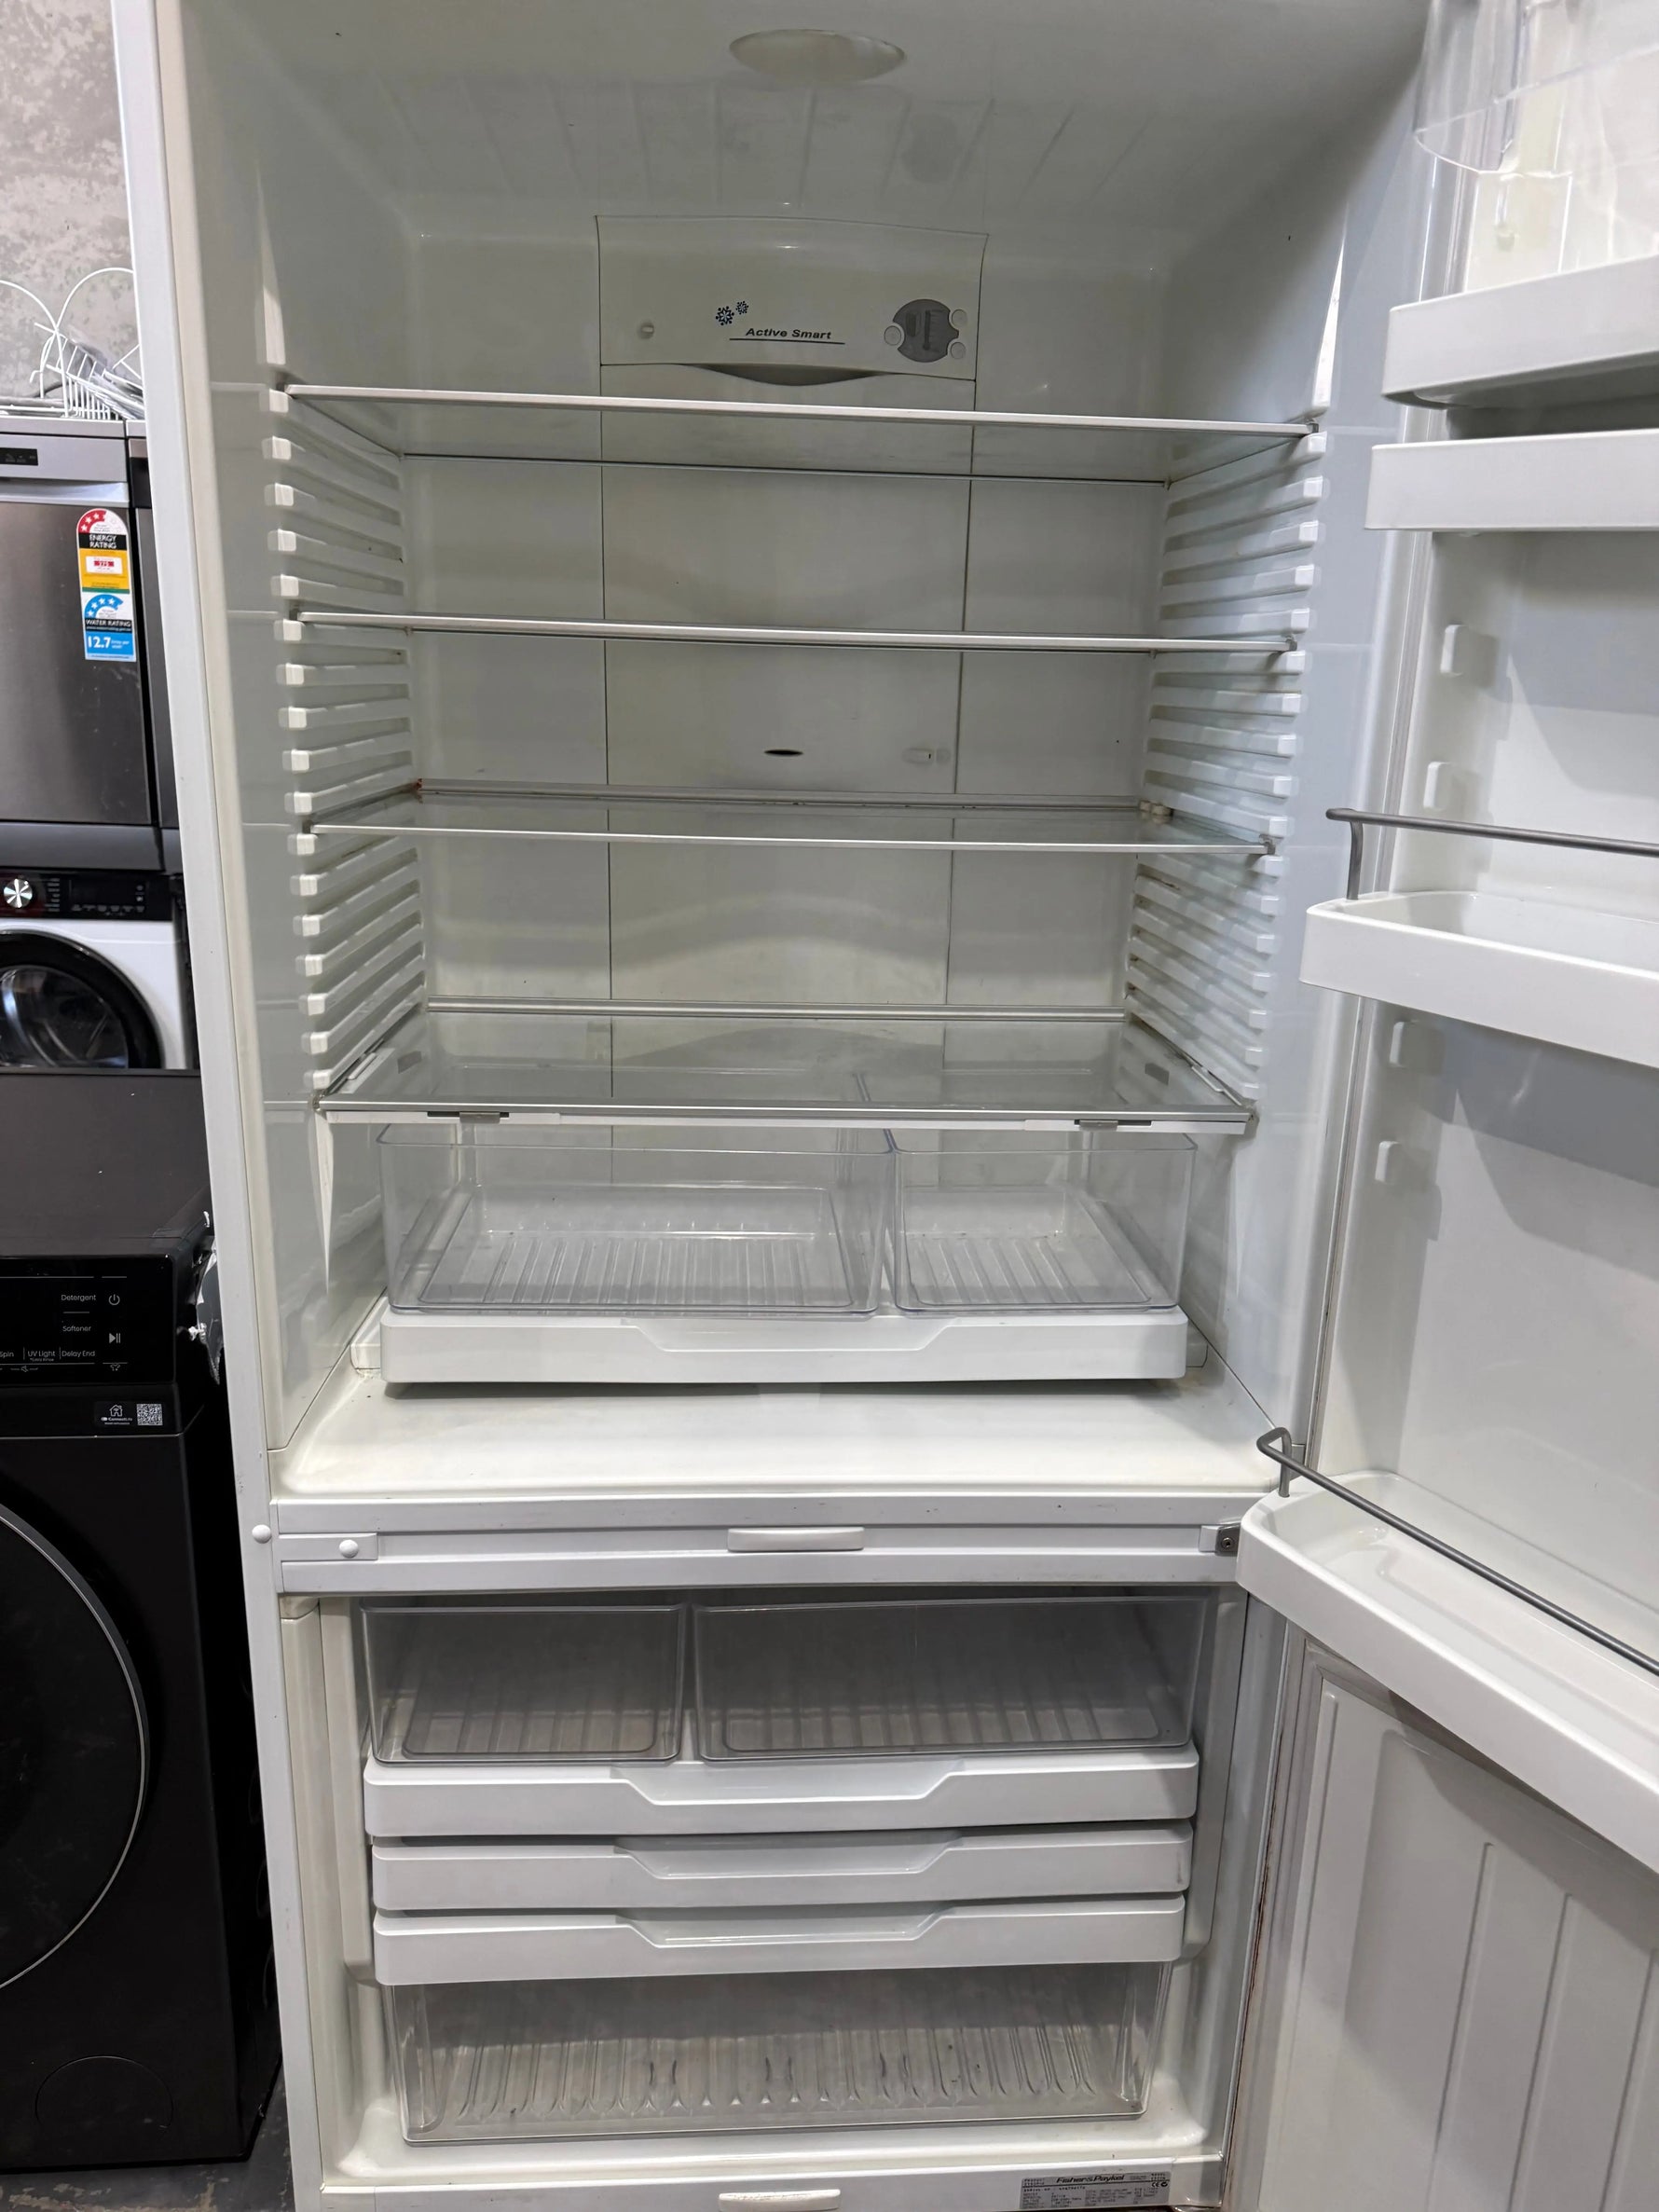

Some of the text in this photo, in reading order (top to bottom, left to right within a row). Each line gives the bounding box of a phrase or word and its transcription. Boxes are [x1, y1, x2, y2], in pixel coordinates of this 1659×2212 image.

[745, 327, 831, 339] Active Smart
[88, 635, 112, 649] 12.7
[61, 1294, 97, 1302] Detergent
